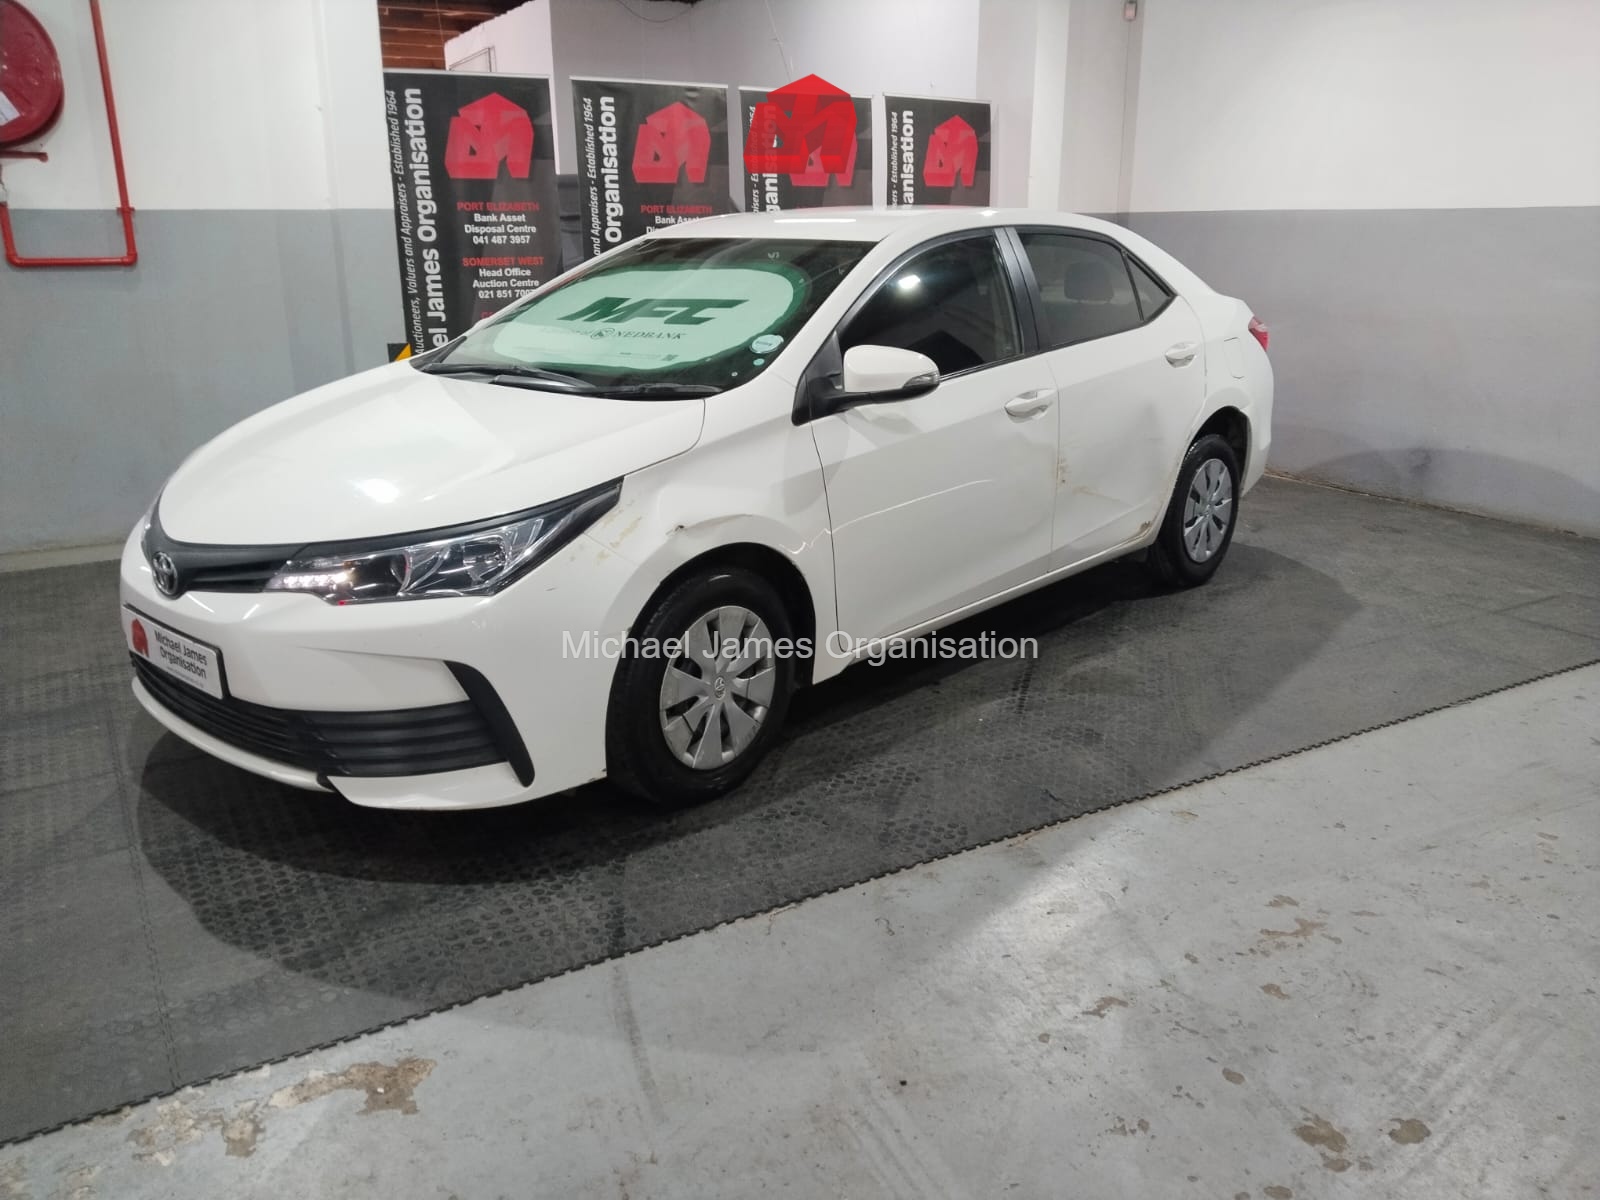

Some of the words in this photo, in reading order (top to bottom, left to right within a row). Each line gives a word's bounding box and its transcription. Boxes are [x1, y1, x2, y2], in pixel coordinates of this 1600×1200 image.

[385, 90, 399, 114] 1964
[582, 97, 593, 123] 1964
[389, 117, 405, 175] Established
[583, 123, 598, 179] Established
[890, 134, 898, 184] Established
[403, 88, 438, 243] Organisation
[598, 96, 624, 244] Organisation
[396, 183, 413, 235] Appraisers
[456, 201, 484, 211] PORT
[473, 212, 498, 222] Bank
[500, 212, 526, 222] Asset
[586, 184, 601, 237] Appraisers
[464, 224, 505, 235] Disposal
[506, 224, 537, 233] Centre
[655, 215, 676, 224] Bank
[400, 236, 415, 256] and
[472, 235, 489, 245] 041
[509, 235, 531, 245] 3957
[592, 237, 601, 257] and
[463, 257, 516, 267] SOMERSET
[518, 256, 545, 266] WEST
[479, 268, 503, 278] Head
[504, 267, 532, 277] Office
[403, 258, 417, 294] Valuers
[422, 248, 446, 322] James
[472, 279, 508, 289] Auction
[509, 279, 540, 288] Centre
[478, 289, 494, 299] 021
[496, 289, 512, 299] 851
[514, 288, 536, 299] 700
[557, 297, 750, 325] MFC
[154, 630, 182, 653] Michael
[183, 645, 208, 666] James
[160, 646, 207, 679] Organisation
